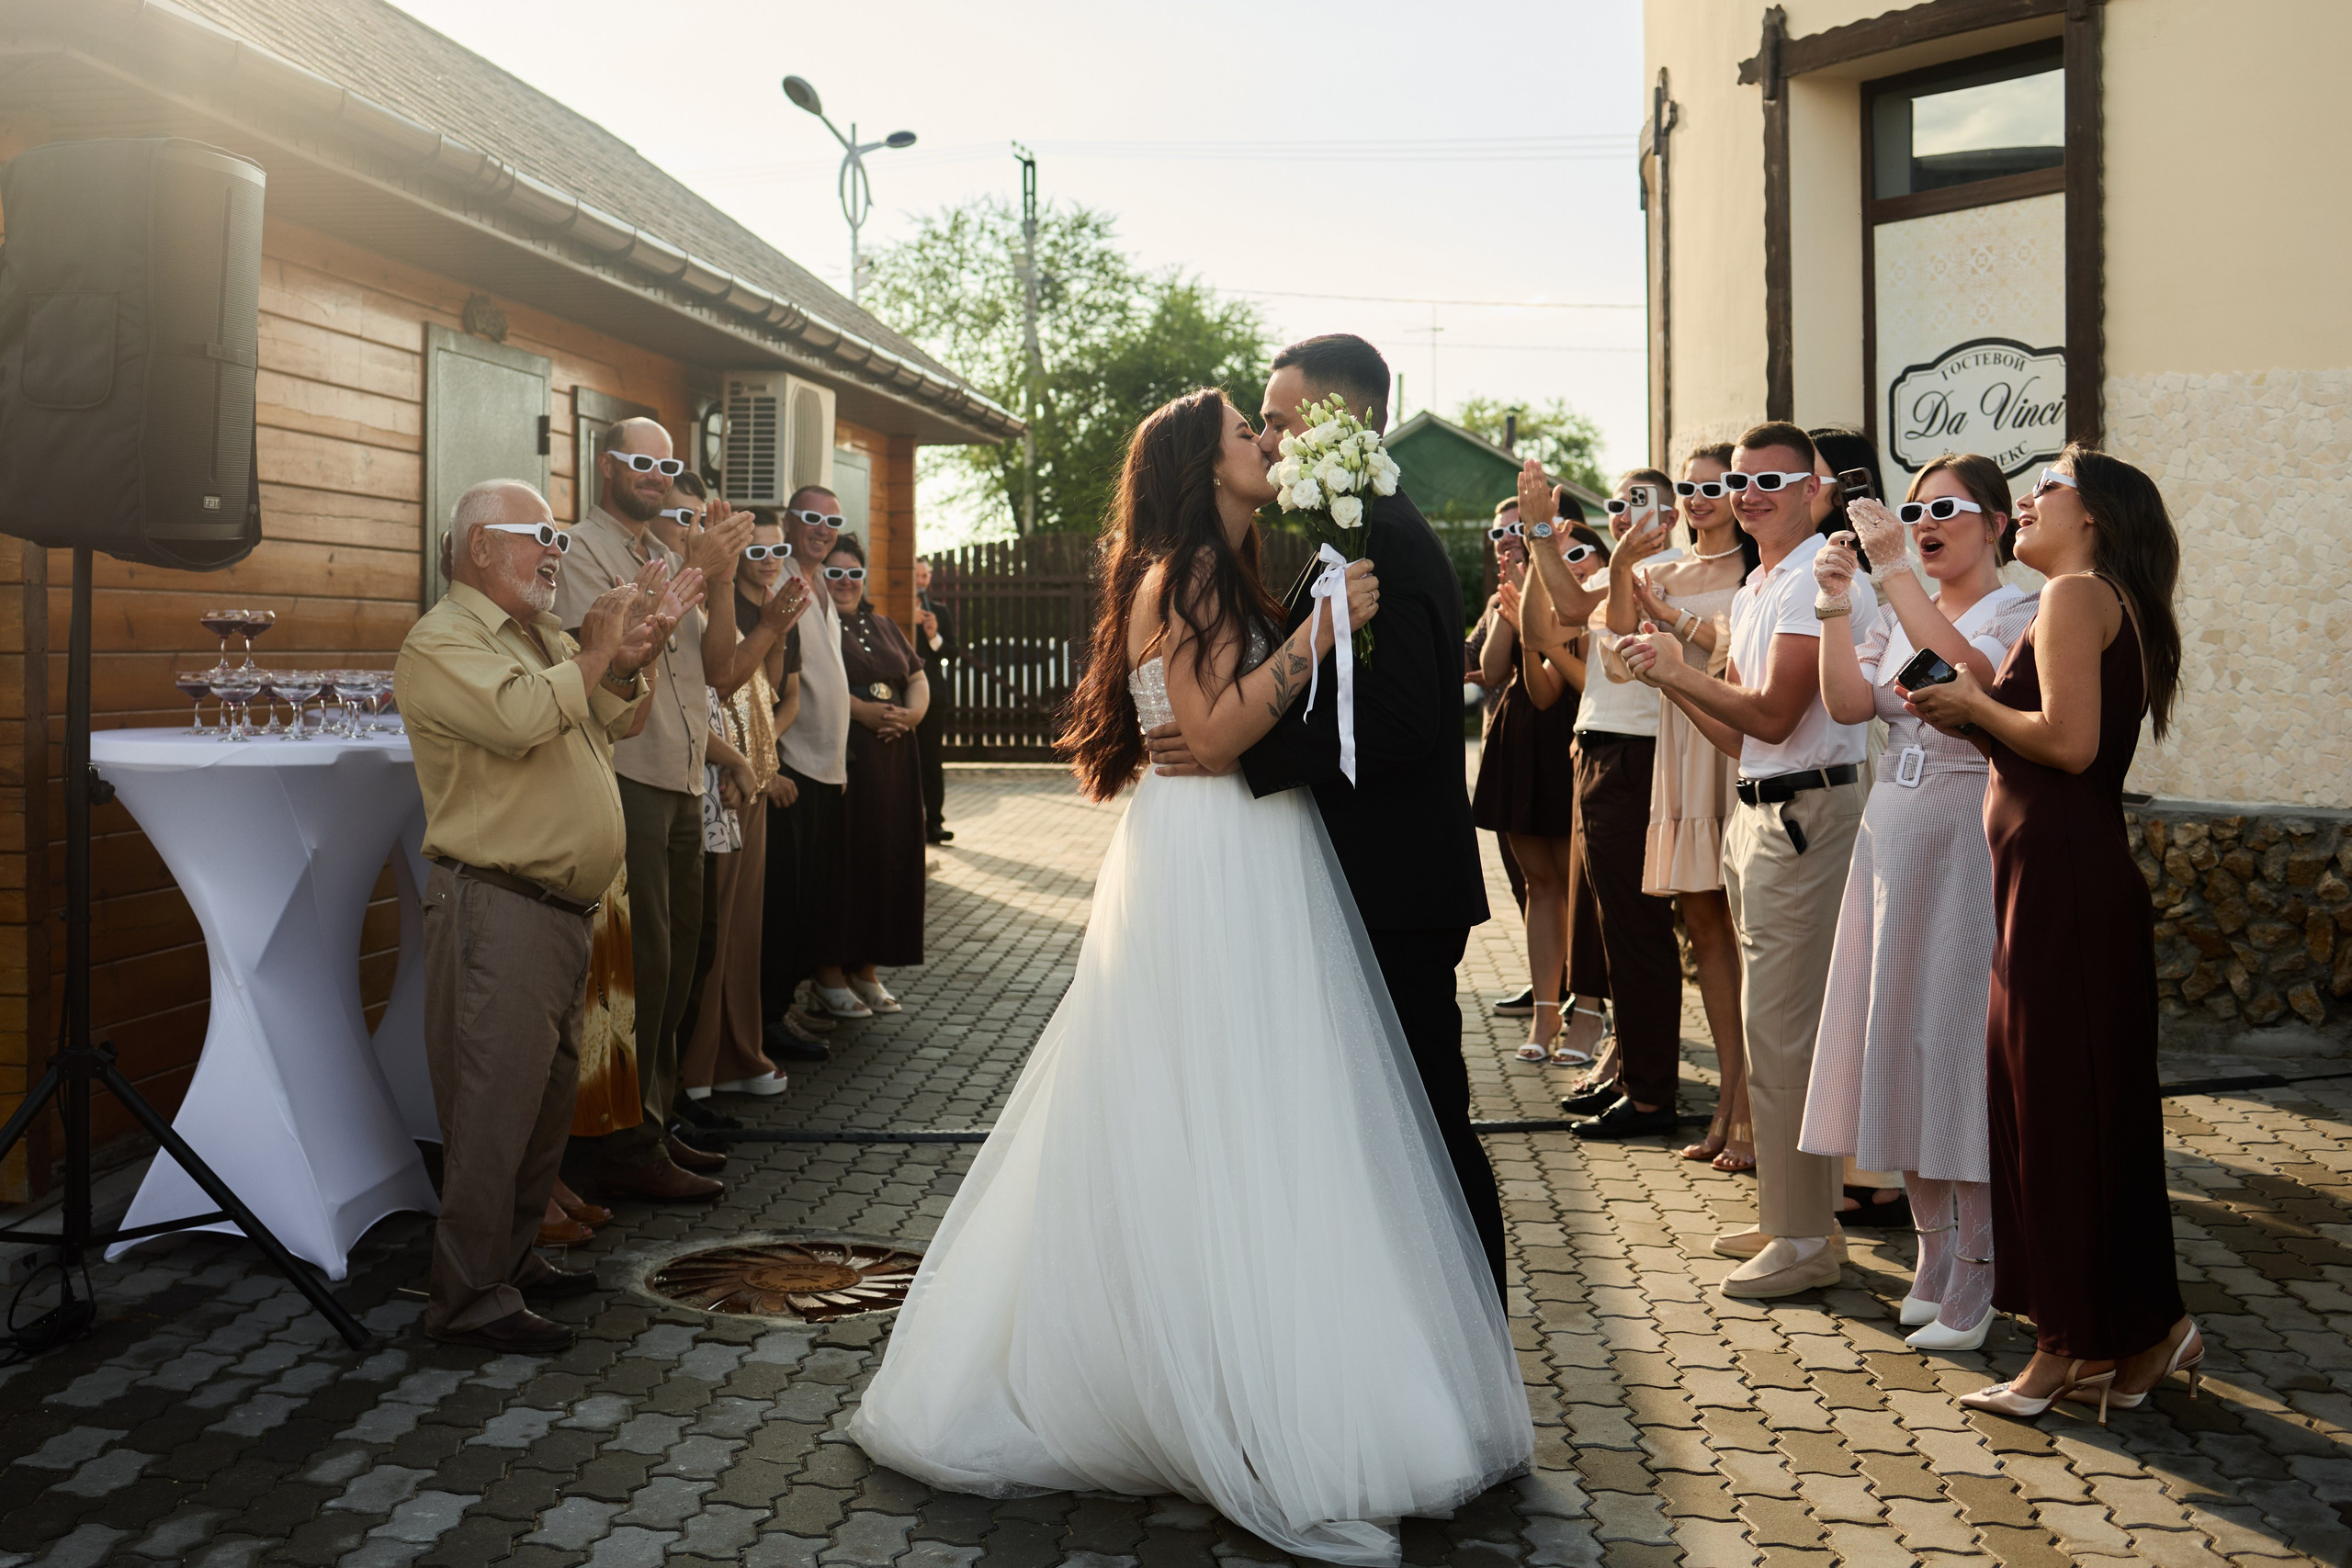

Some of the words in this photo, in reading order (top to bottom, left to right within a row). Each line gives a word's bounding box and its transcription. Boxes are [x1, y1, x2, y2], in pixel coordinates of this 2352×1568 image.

[1940, 353, 2027, 381] ГОСТЕВОЙ
[1905, 389, 1970, 440] Da
[1980, 376, 2066, 431] Vinci
[205, 498, 220, 507] FBT
